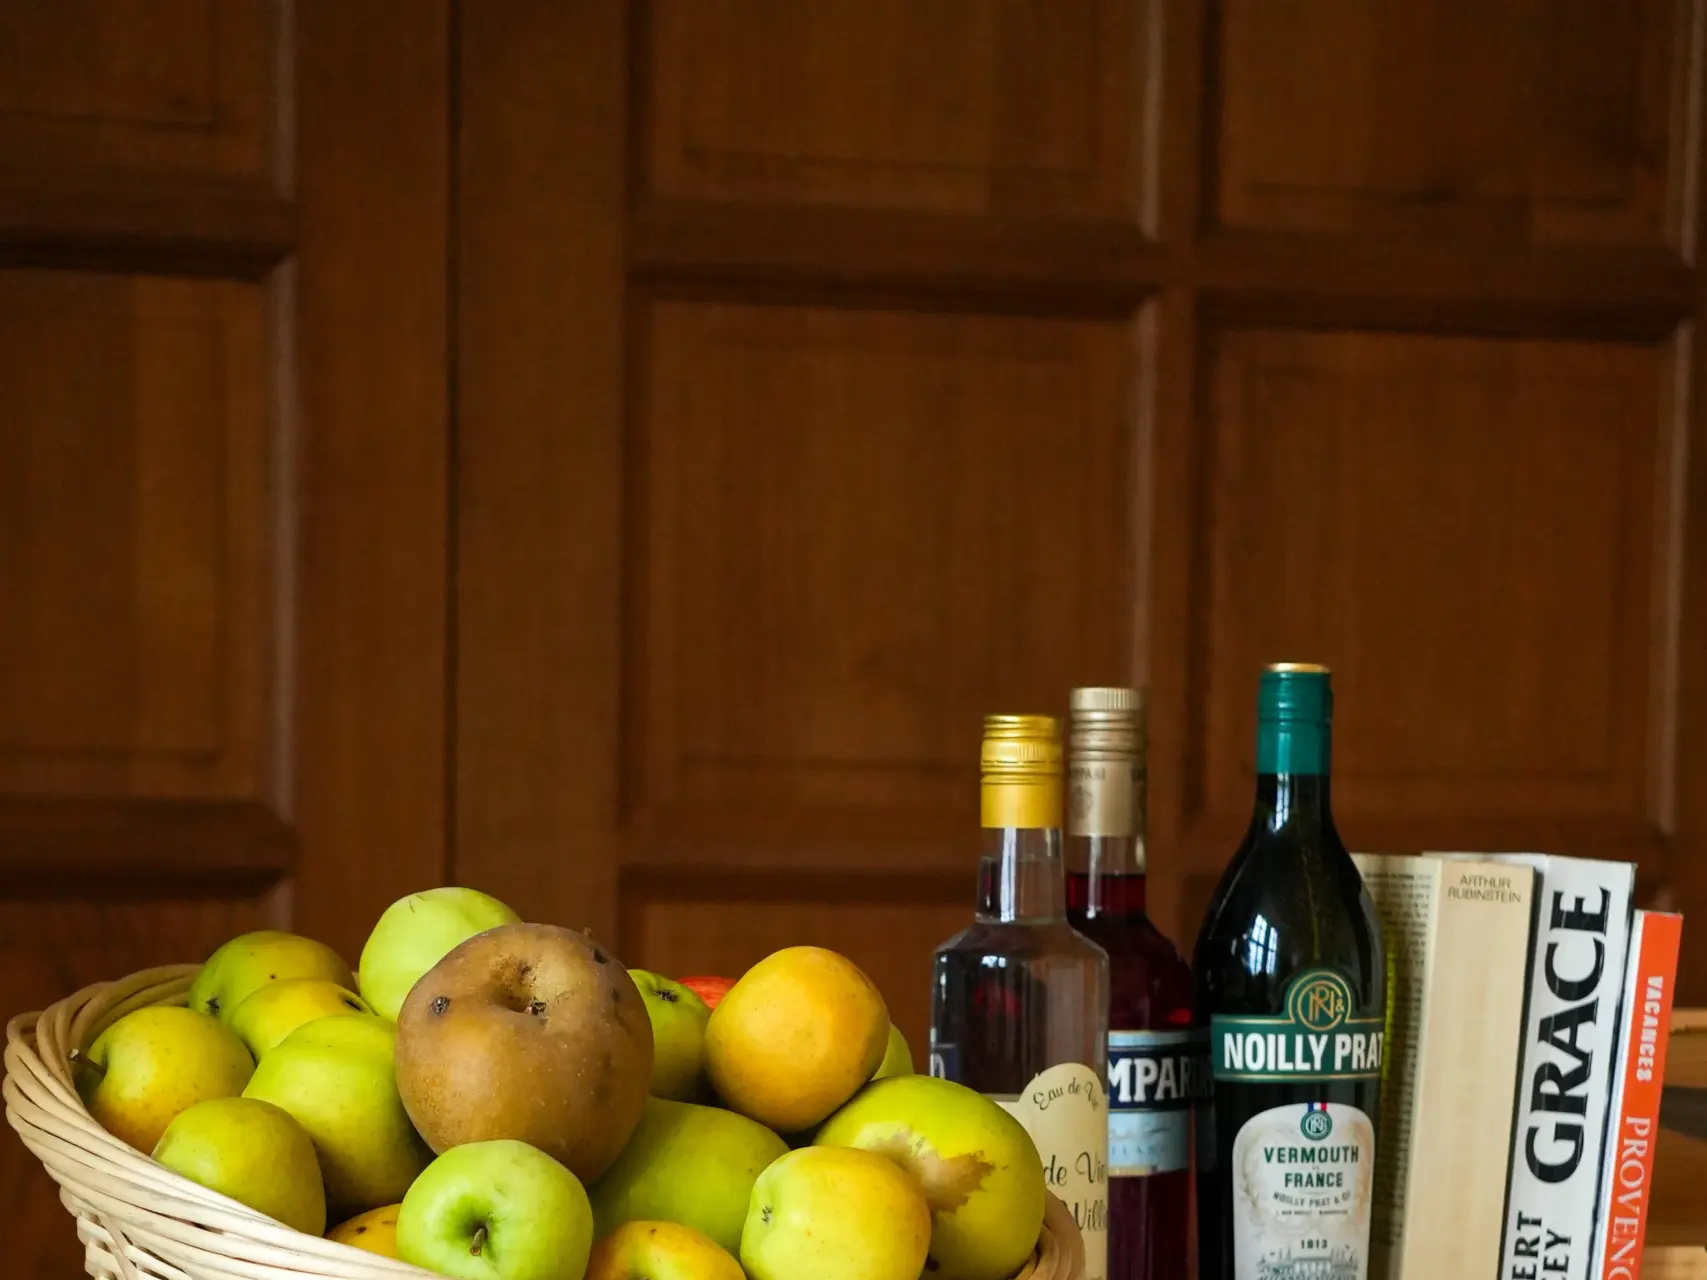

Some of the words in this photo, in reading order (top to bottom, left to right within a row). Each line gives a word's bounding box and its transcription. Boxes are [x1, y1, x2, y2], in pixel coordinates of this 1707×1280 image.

[1447, 886, 1521, 904] RUBINSTEIN
[1459, 874, 1511, 889] ARTHUR
[1525, 885, 1611, 1184] GRACE
[1636, 975, 1664, 1083] VACANCES
[1224, 1033, 1329, 1071] NOILLY
[1033, 1086, 1064, 1111] Eau
[1068, 1076, 1081, 1094] de
[1263, 1145, 1359, 1165] VERMOUTH
[1284, 1172, 1343, 1188] FRANCE
